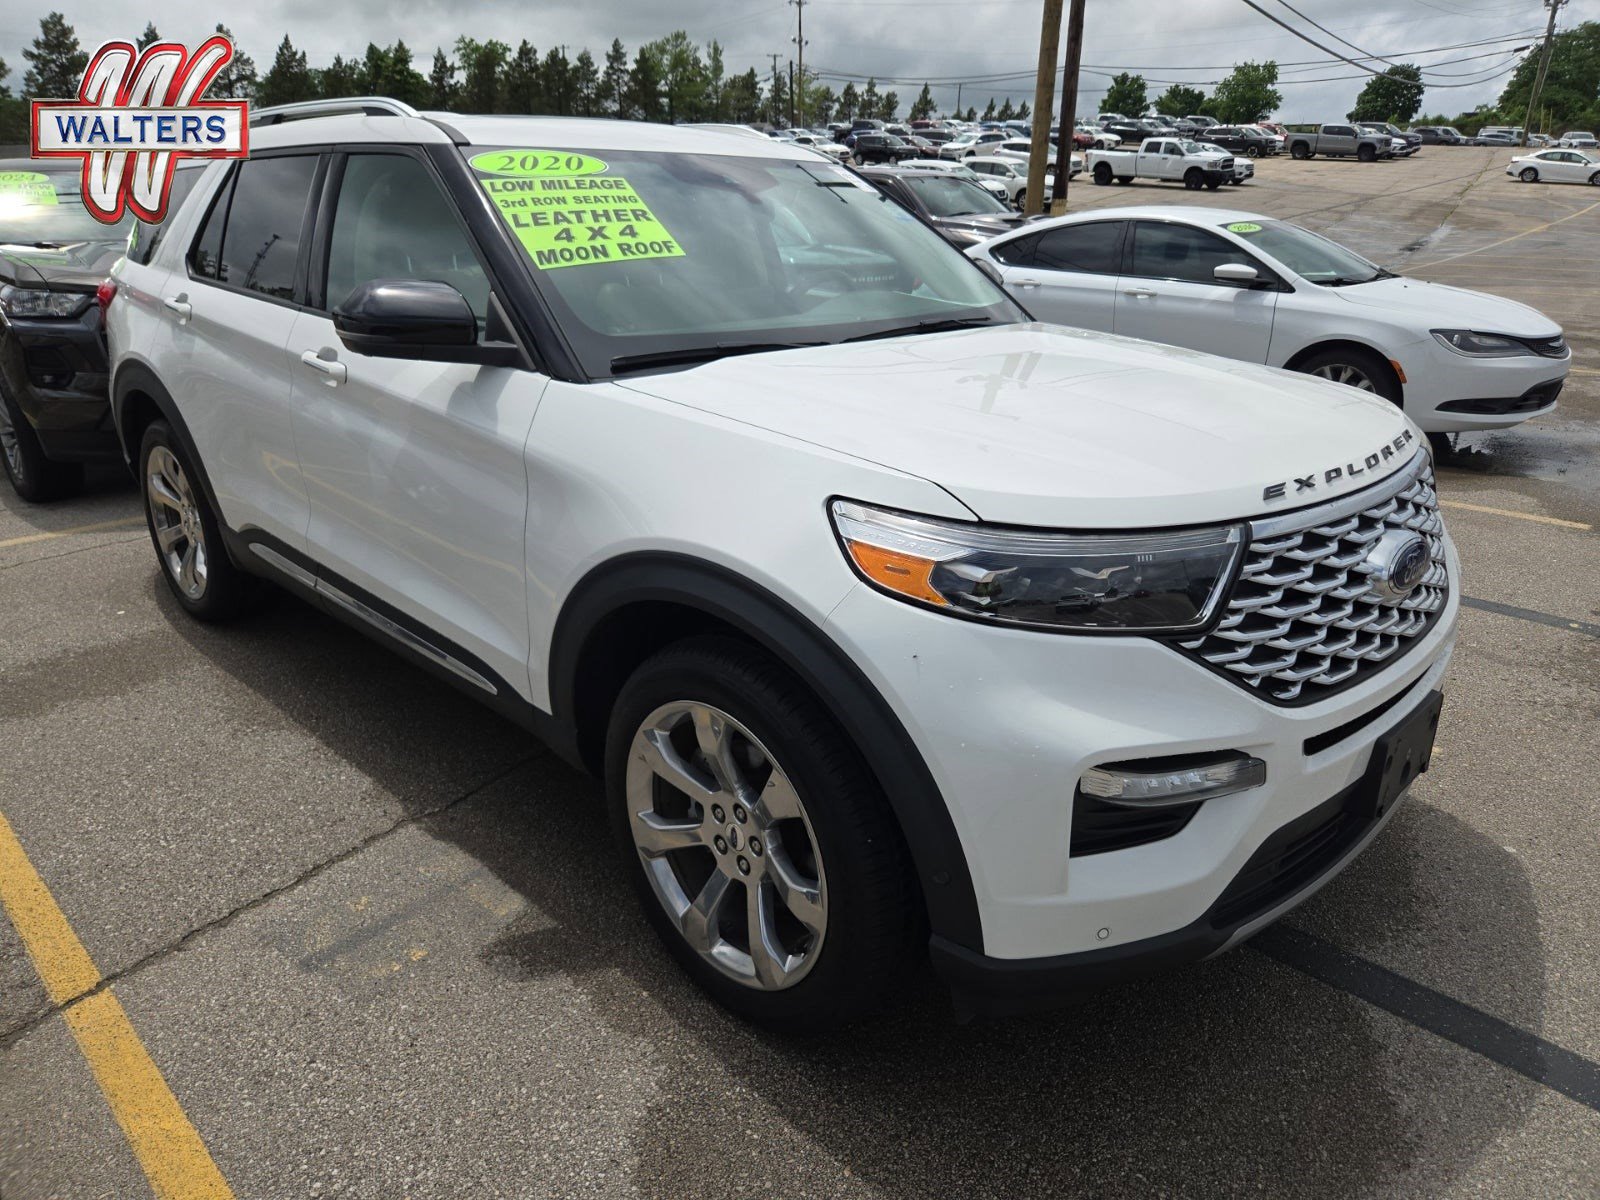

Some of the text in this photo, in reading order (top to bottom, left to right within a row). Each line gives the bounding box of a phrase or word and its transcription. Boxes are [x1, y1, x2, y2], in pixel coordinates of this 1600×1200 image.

[496, 155, 584, 171] 2020
[490, 179, 627, 193] LOW MILEAGE
[500, 195, 638, 209] 3rd ROW SEATING
[512, 208, 653, 228] LEATHER
[554, 228, 575, 243] 4
[619, 224, 639, 238] 4
[536, 240, 676, 266] MOON ROOF
[1263, 429, 1413, 500] EXPLORER
